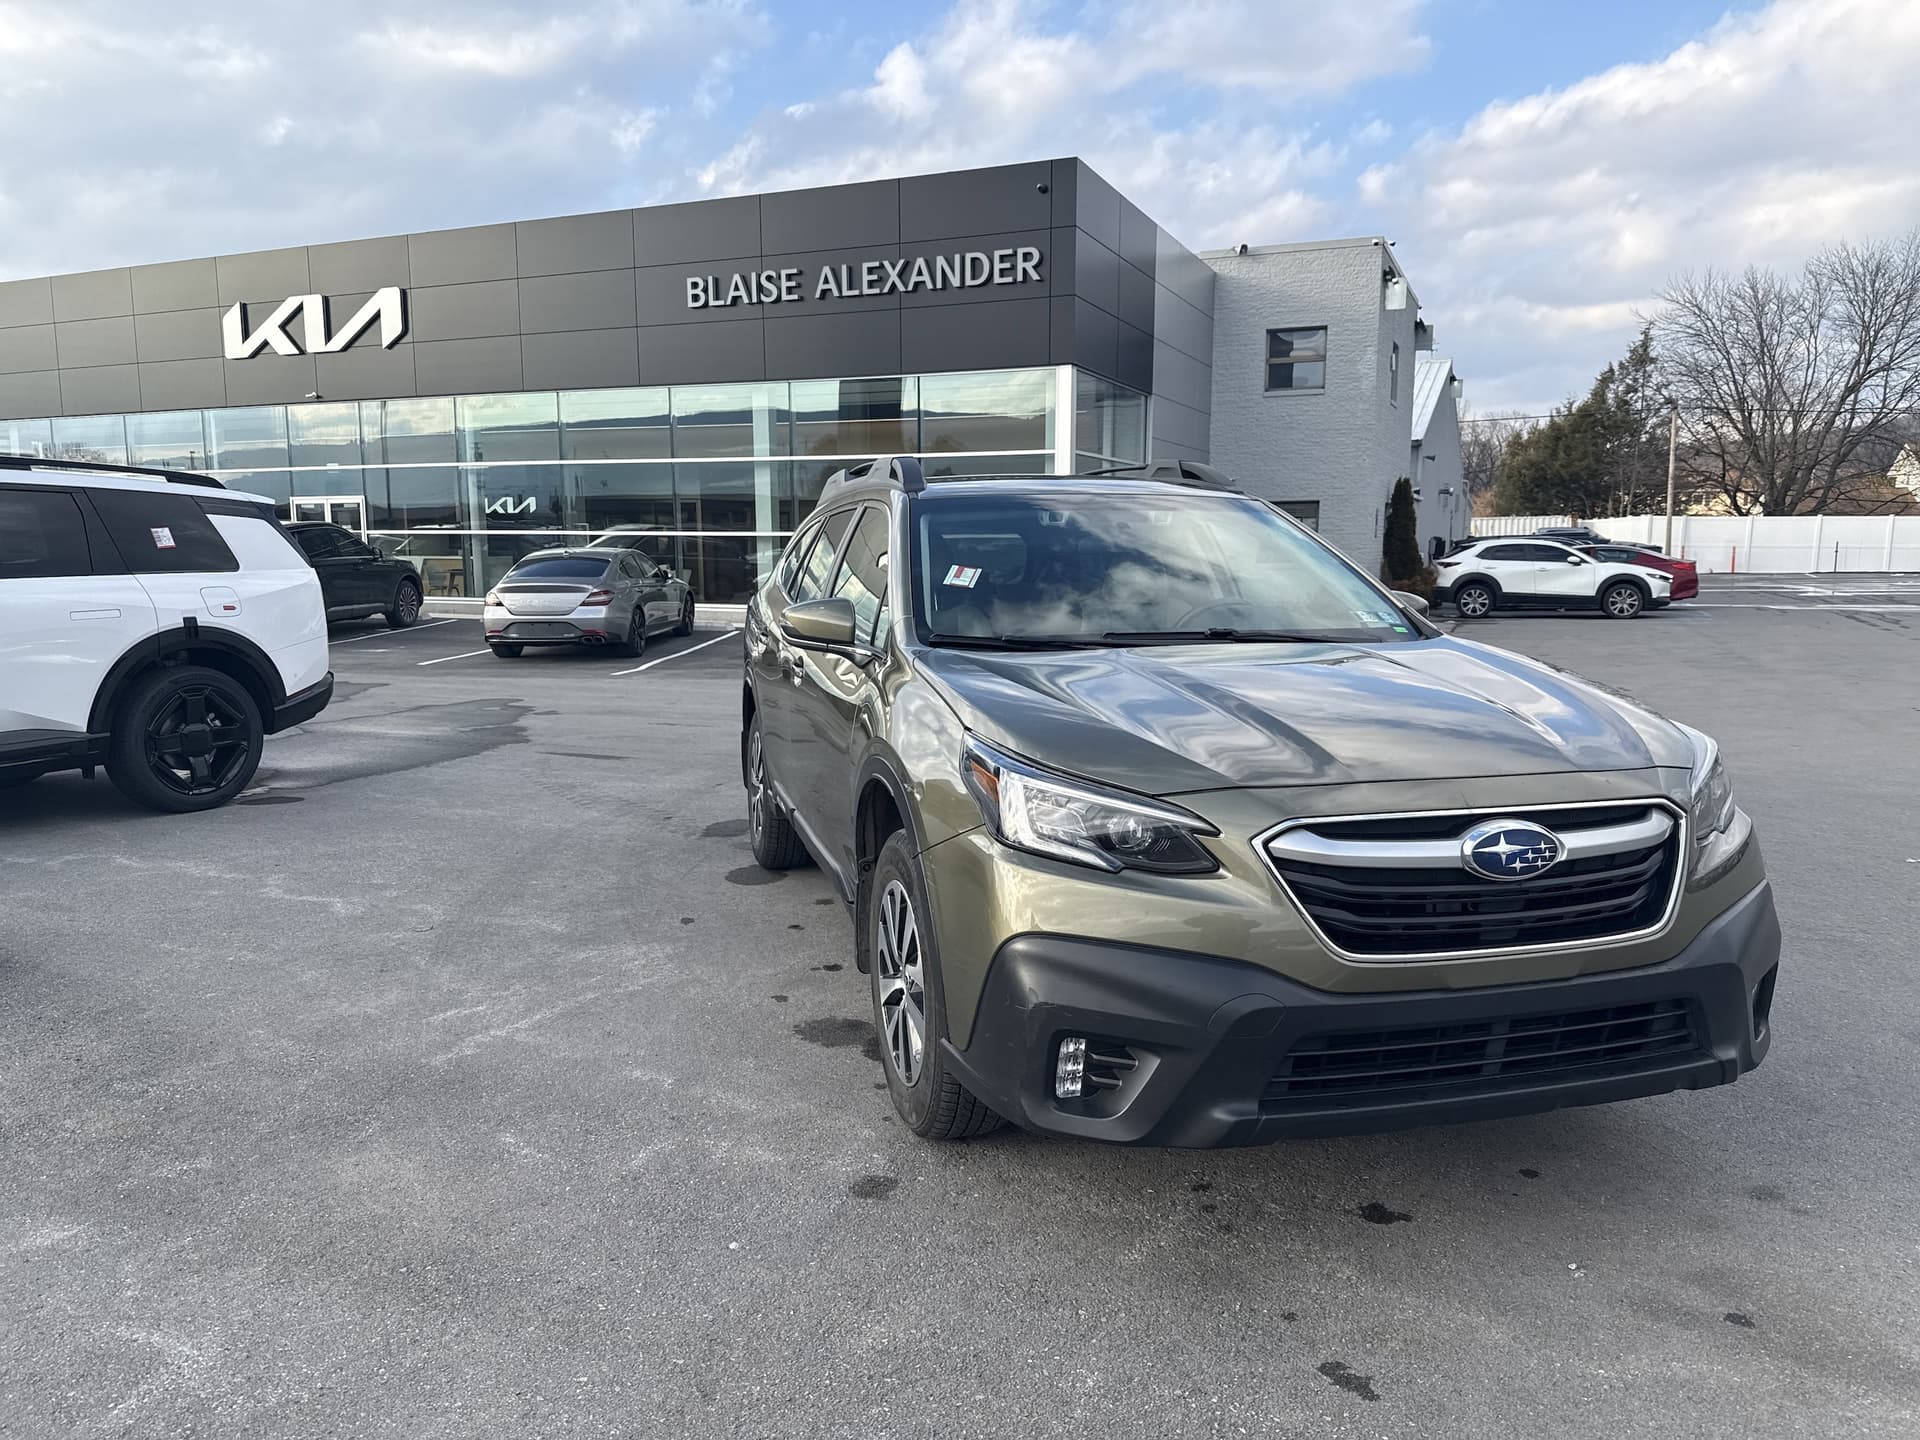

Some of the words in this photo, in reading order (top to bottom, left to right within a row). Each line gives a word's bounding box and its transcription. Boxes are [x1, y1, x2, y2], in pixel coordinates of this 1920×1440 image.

[686, 268, 800, 308] BLAISE
[815, 246, 1042, 299] ALEXANDER
[222, 286, 405, 360] KIA
[484, 496, 537, 514] KIA
